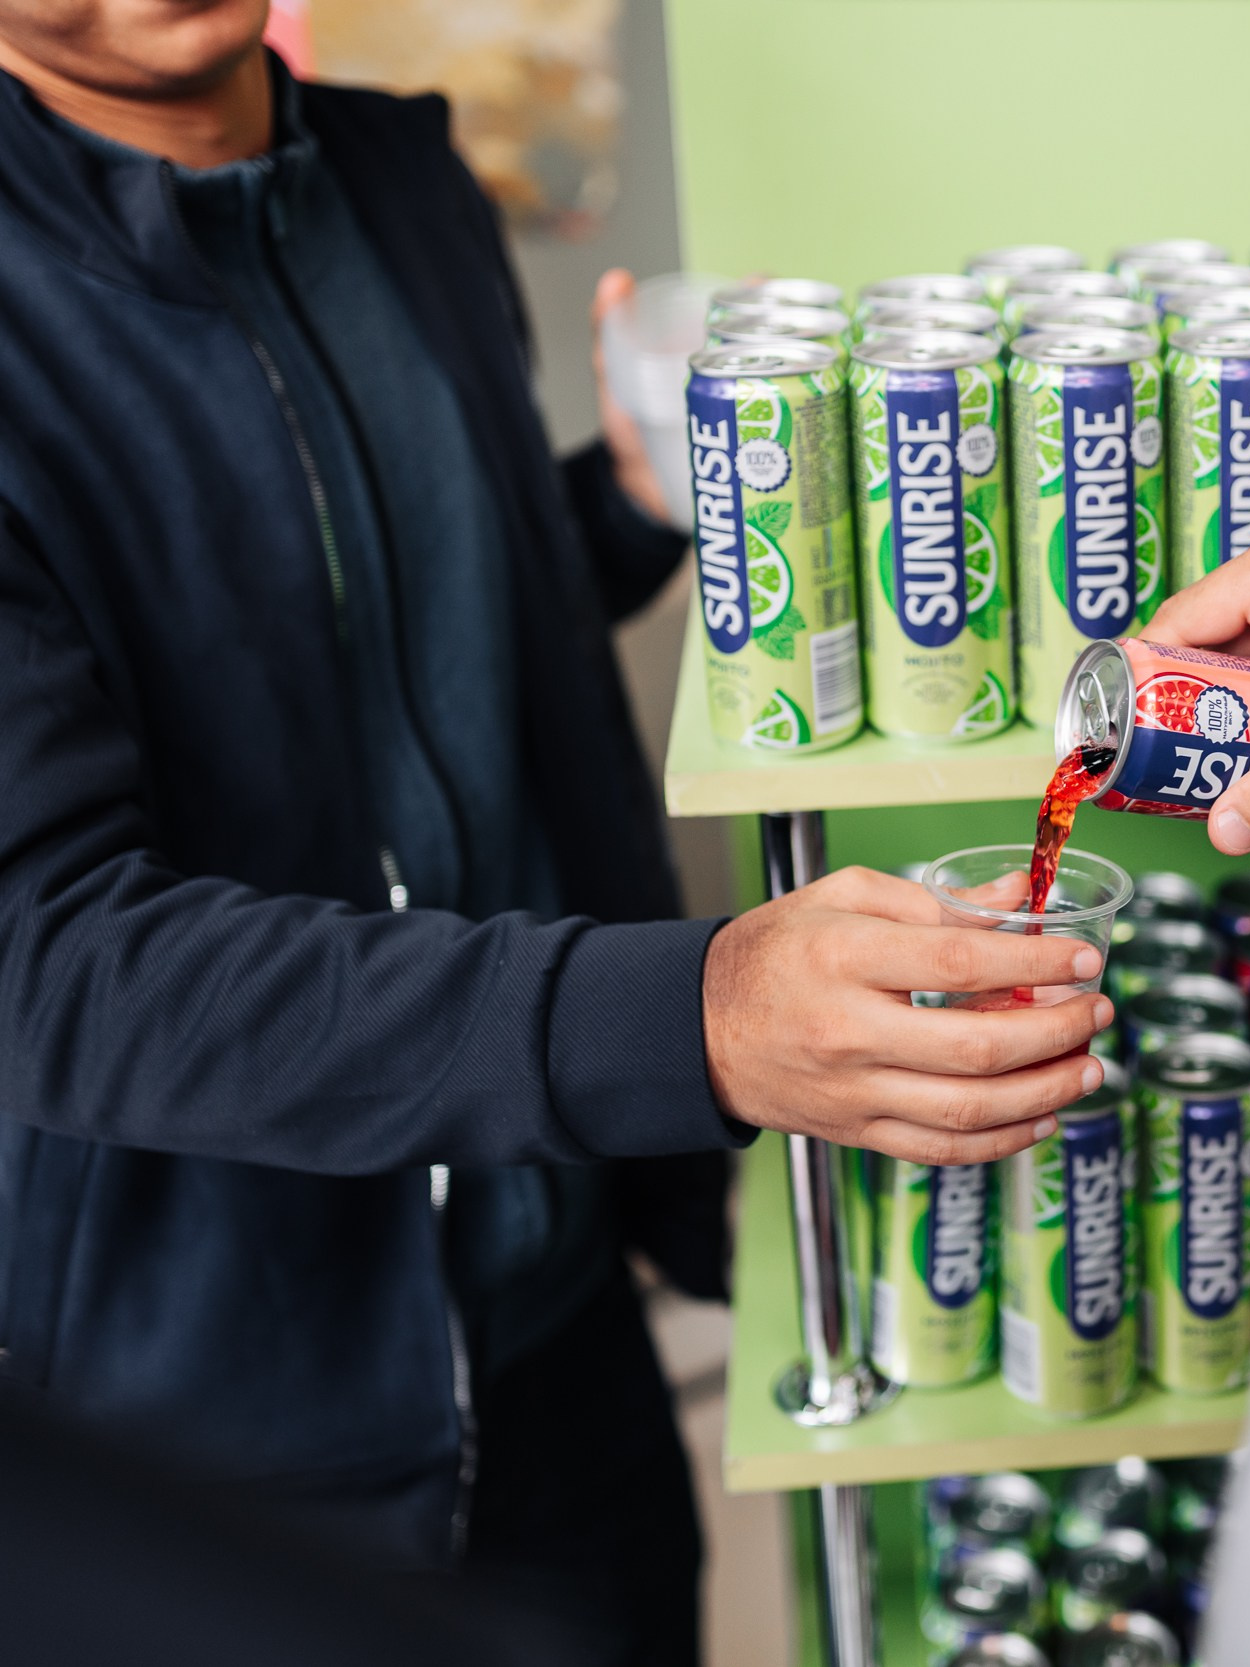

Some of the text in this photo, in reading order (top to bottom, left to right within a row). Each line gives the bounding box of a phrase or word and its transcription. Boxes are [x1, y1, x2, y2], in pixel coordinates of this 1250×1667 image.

[691, 414, 744, 636] SUNRISE
[896, 410, 959, 627] SUNRISE
[1073, 404, 1130, 620] SUNRISE
[1208, 700, 1222, 732] 100%
[1073, 1147, 1121, 1327] SUNRISE
[1188, 1129, 1238, 1306] SUNRISE
